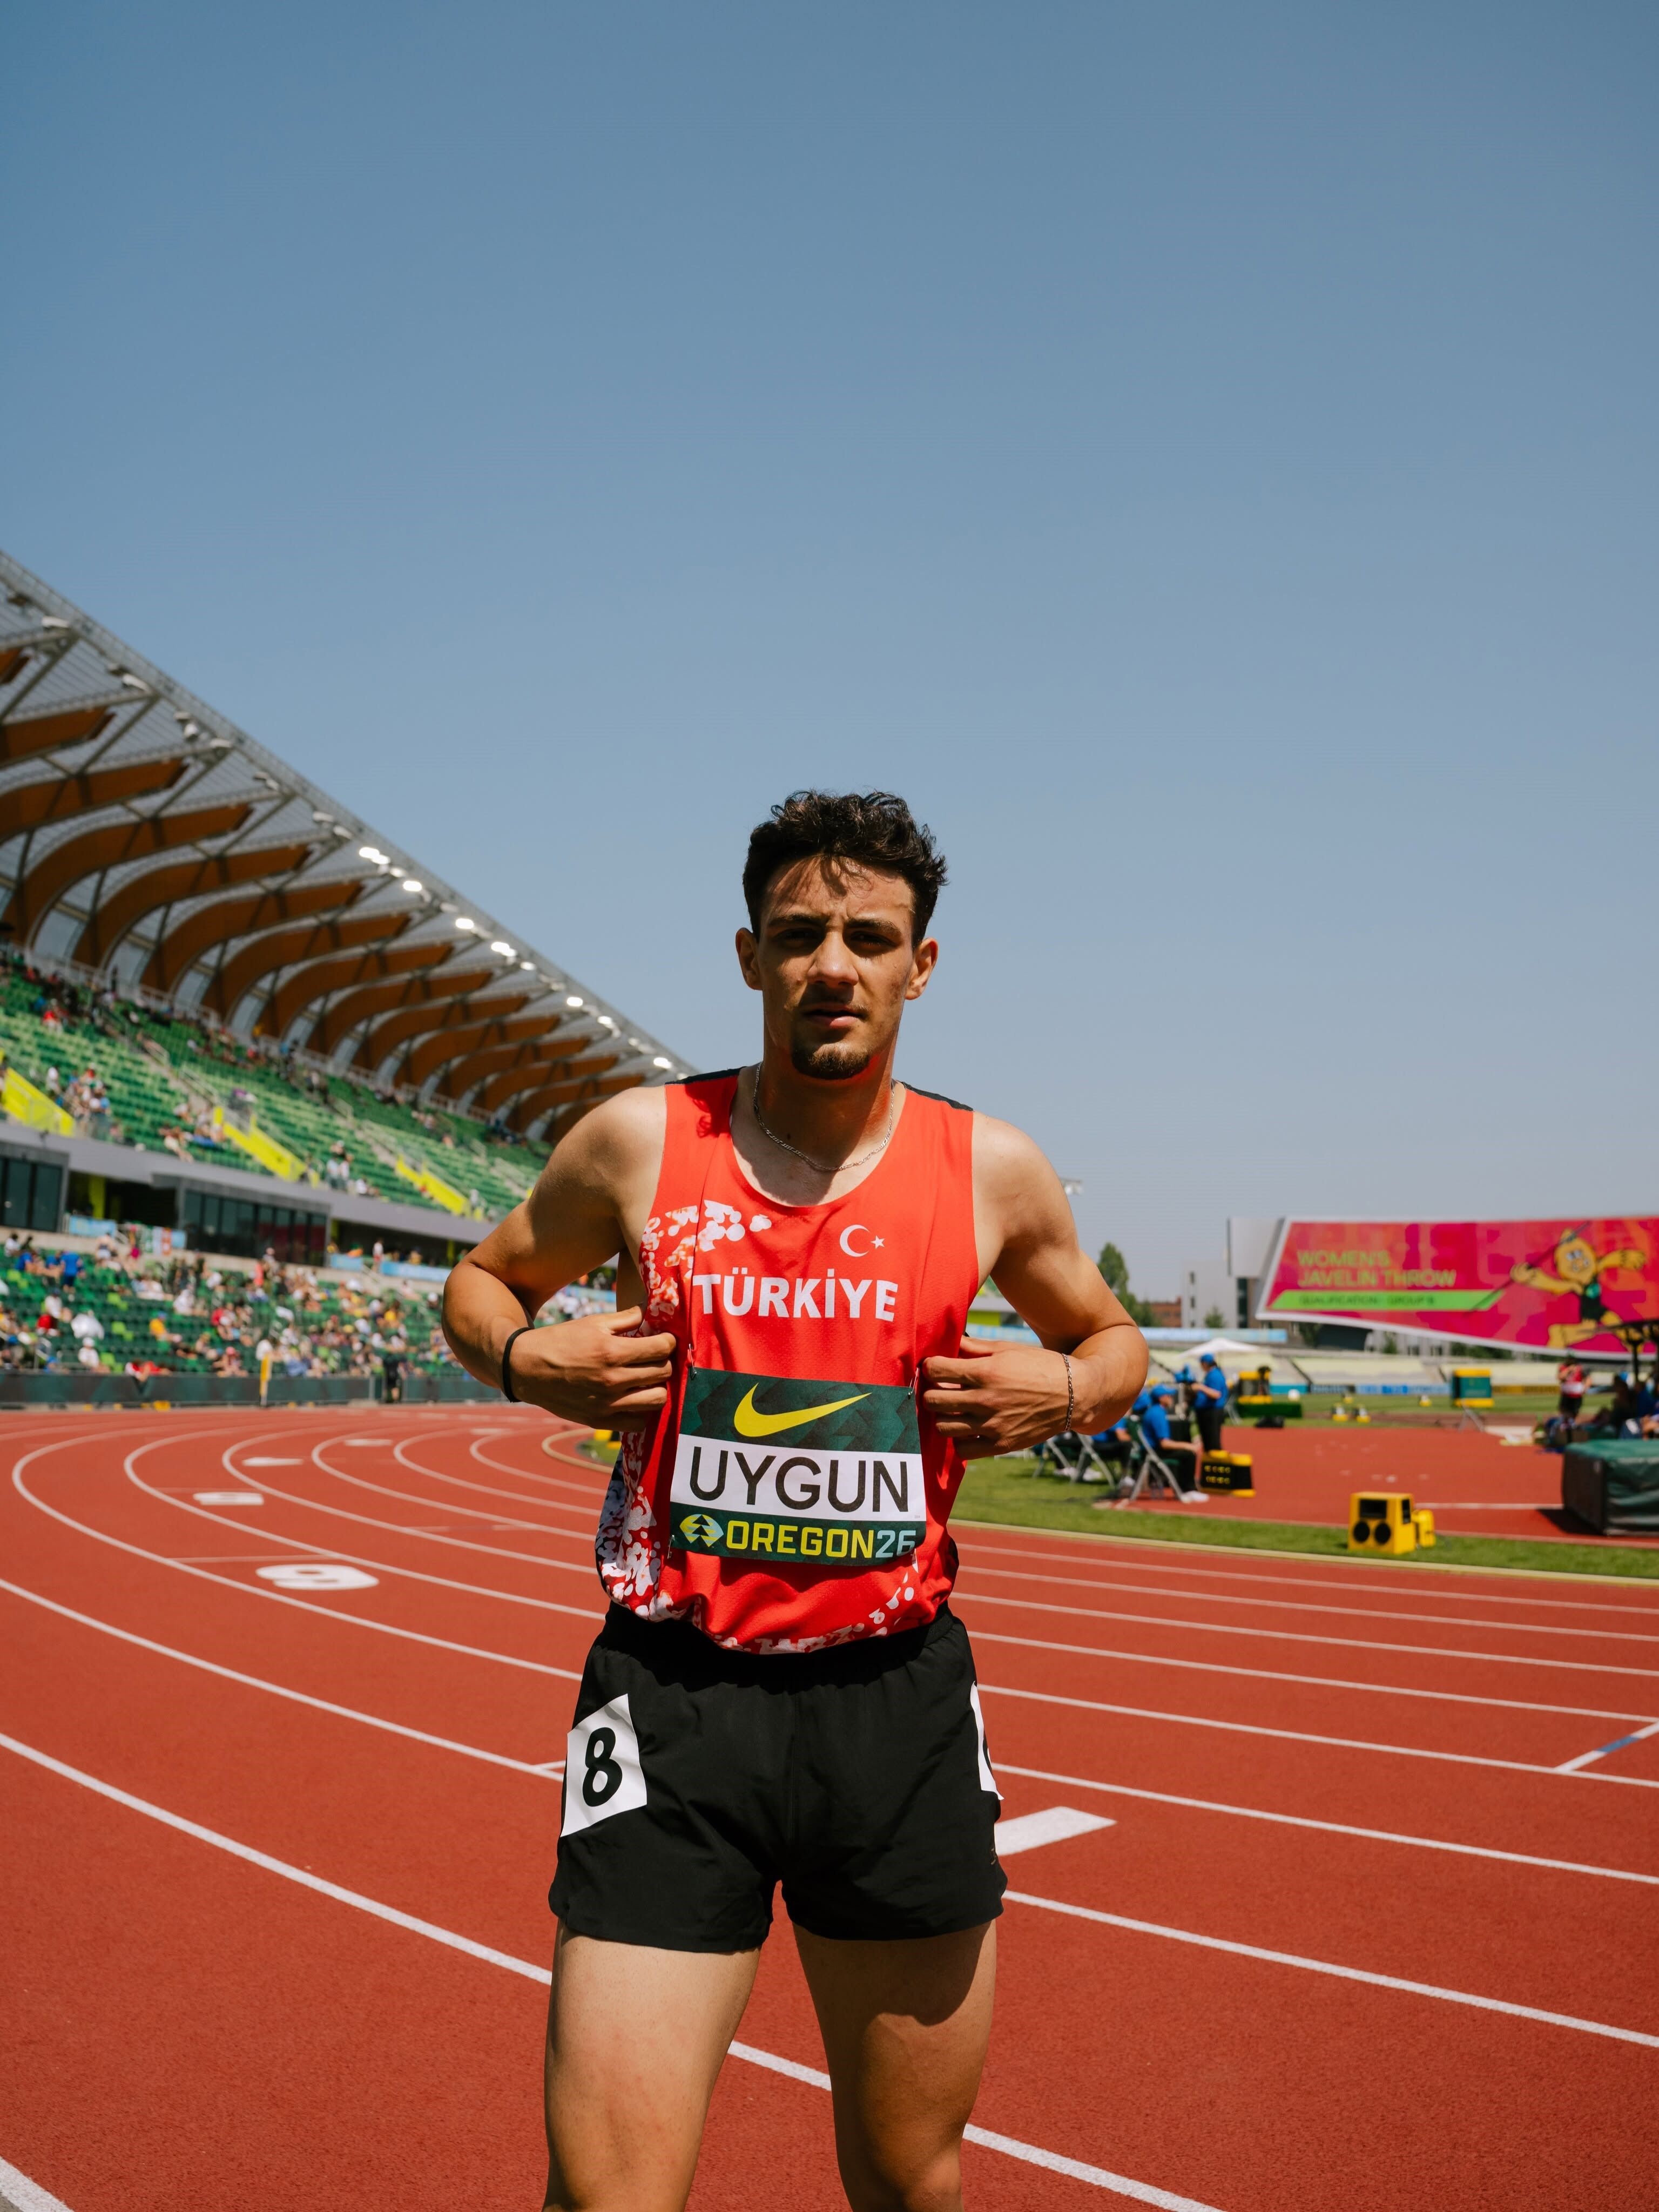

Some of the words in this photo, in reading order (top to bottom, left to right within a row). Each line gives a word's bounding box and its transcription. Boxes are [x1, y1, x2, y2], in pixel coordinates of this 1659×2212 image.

[1298, 1250, 1390, 1267] WOMEN'S
[1298, 1269, 1377, 1287] JAVELIN
[1384, 1269, 1456, 1287] THROW
[692, 1267, 899, 1322] TÜRKİYE
[689, 1446, 909, 1513] UYGUN
[726, 1520, 916, 1559] OREGON26
[582, 1727, 623, 1808] 8
